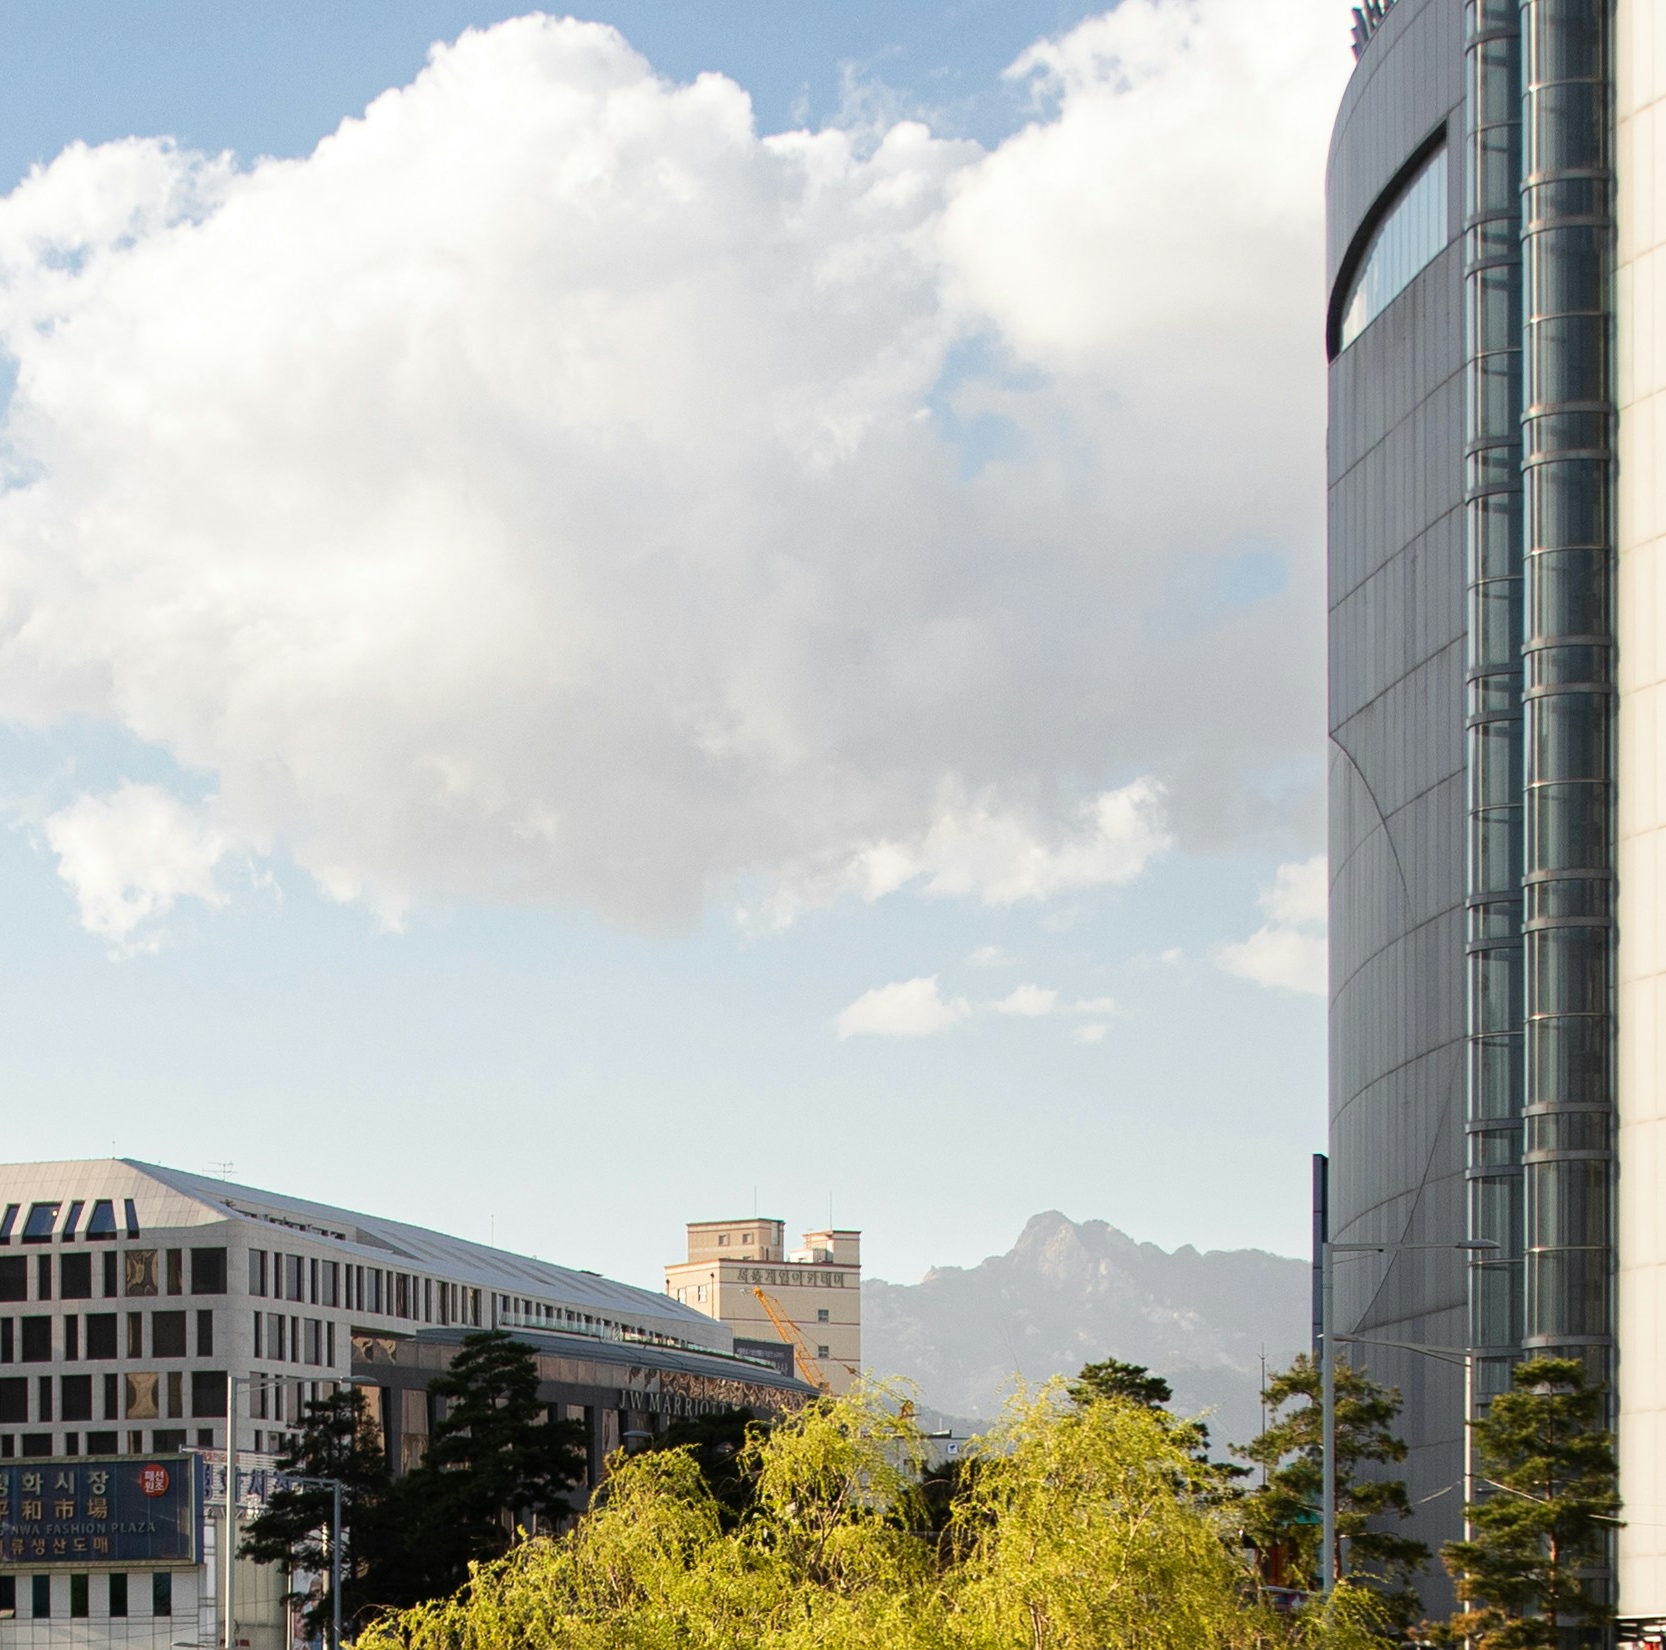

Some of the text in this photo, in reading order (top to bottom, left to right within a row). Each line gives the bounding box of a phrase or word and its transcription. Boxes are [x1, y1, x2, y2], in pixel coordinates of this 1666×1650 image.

[619, 1390, 728, 1417] JW MARRIOTT
[46, 1523, 106, 1535] FASHION
[111, 1521, 156, 1533] PLAZA
